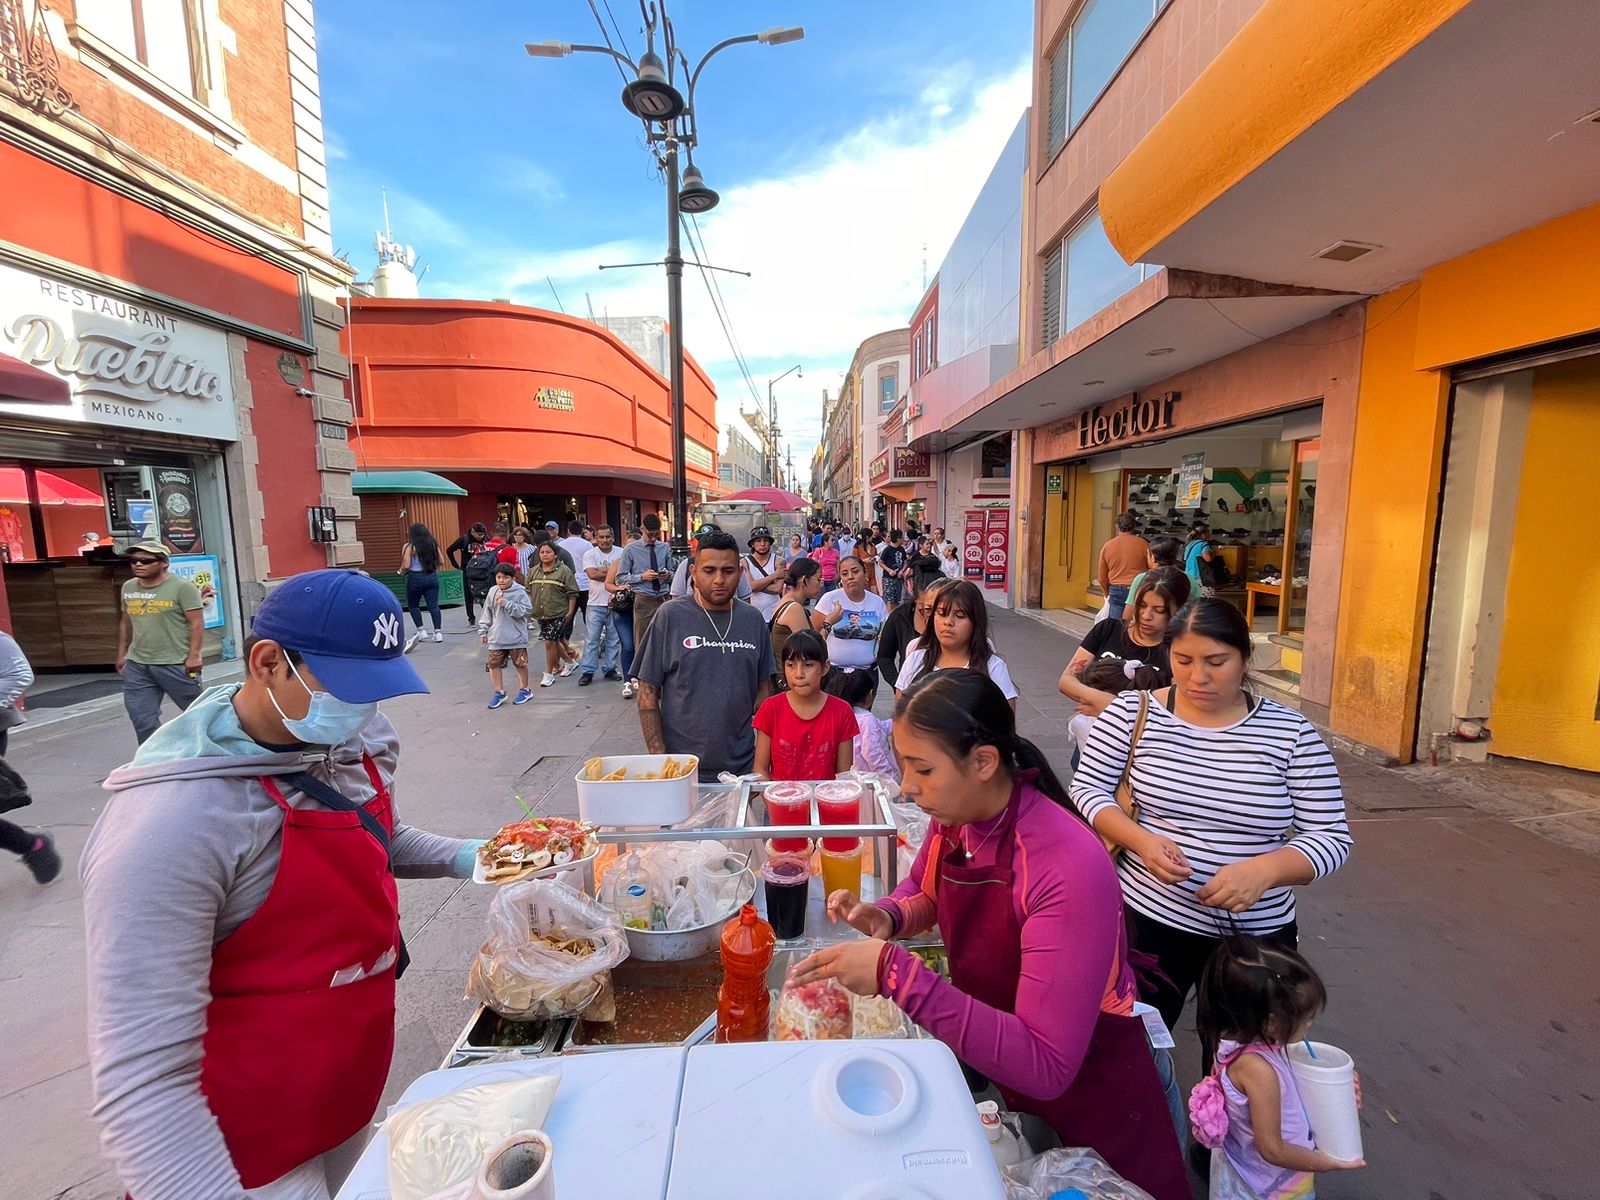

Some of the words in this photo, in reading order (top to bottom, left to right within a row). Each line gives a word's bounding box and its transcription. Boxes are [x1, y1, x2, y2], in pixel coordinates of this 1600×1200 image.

[40, 278, 178, 334] RESTAURANT
[4, 313, 222, 402] Pueblito
[91, 402, 164, 422] MEXICANO
[1077, 392, 1177, 449] Hector
[897, 456, 926, 468] petit
[372, 612, 400, 650] NY
[683, 635, 757, 652] Champion
